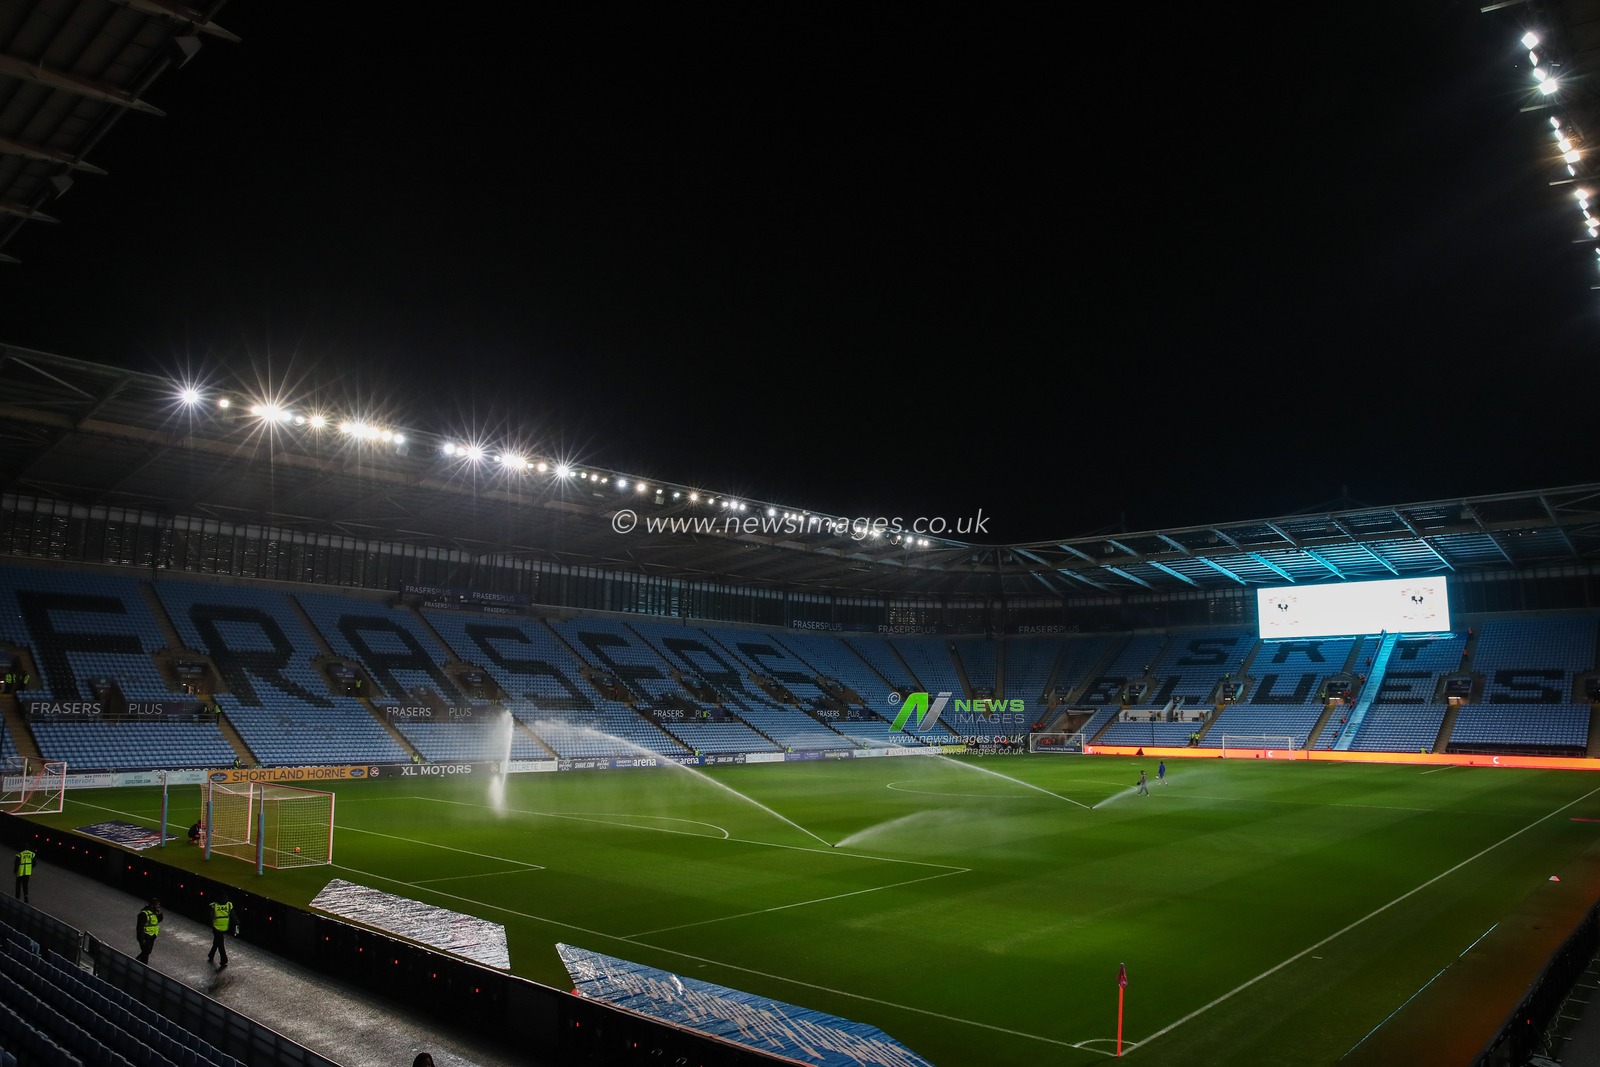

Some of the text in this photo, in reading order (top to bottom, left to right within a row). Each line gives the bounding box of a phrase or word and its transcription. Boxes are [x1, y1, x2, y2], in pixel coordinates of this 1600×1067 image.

[16, 590, 845, 712] FRASERS
[30, 702, 163, 716] FRASERS PLUS
[386, 706, 472, 717] FRASERS PLUS
[653, 709, 712, 718] FRASERS PLS
[847, 709, 860, 718] PLUS
[633, 758, 657, 767] arena
[232, 769, 304, 782] SHORTLAND
[307, 768, 346, 779] HORNE
[401, 765, 472, 776] XL MOTORS
